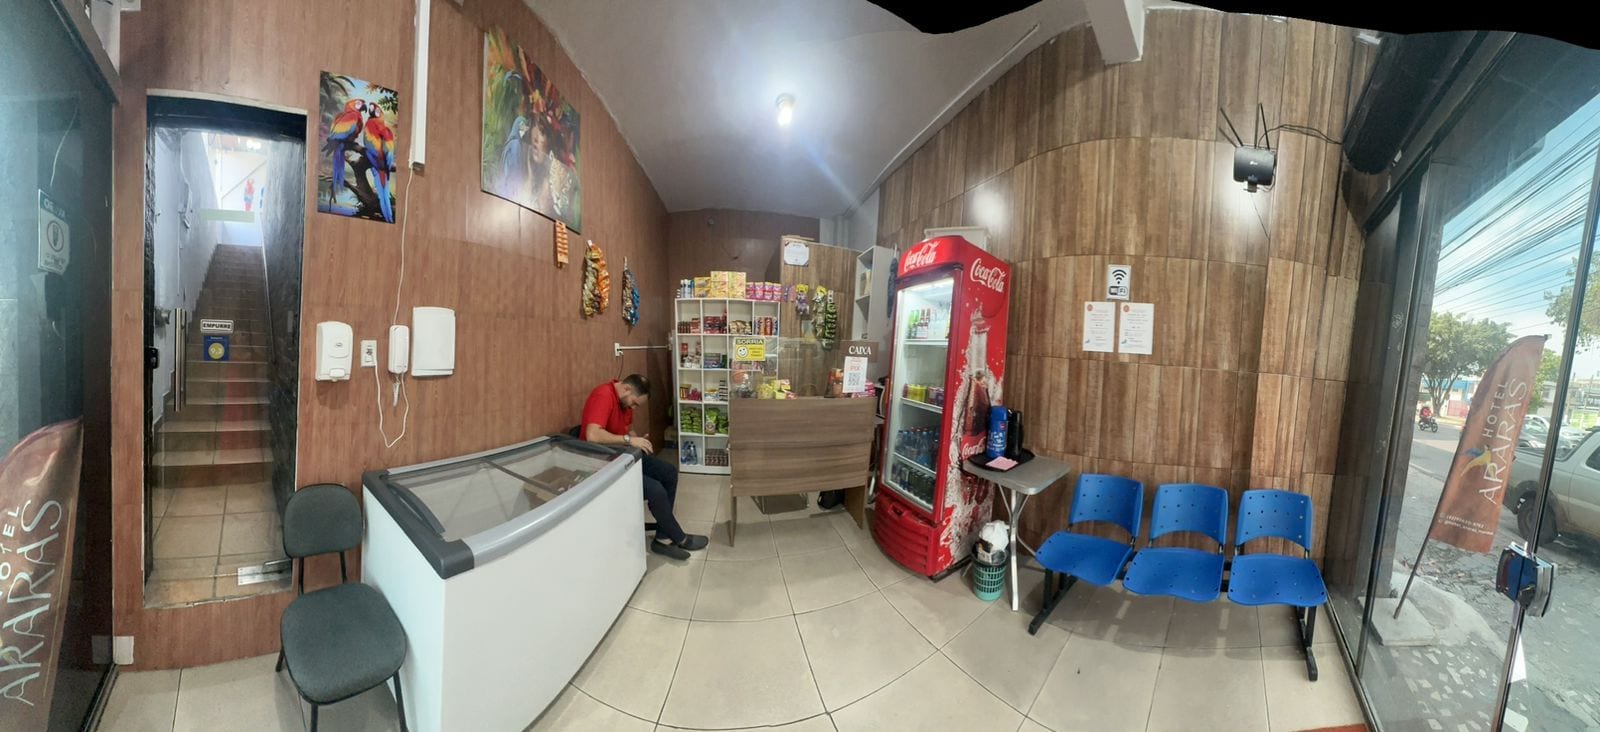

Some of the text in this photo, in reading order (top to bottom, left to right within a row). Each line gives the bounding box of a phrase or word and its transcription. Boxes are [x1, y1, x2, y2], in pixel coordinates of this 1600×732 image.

[970, 258, 1006, 293] Coca-Cola
[848, 345, 872, 355] CAIXA
[1479, 378, 1527, 504] ARARAS
[1482, 382, 1509, 438] HOTEL
[0, 506, 21, 595] OTEL
[0, 499, 62, 707] ARARAS
